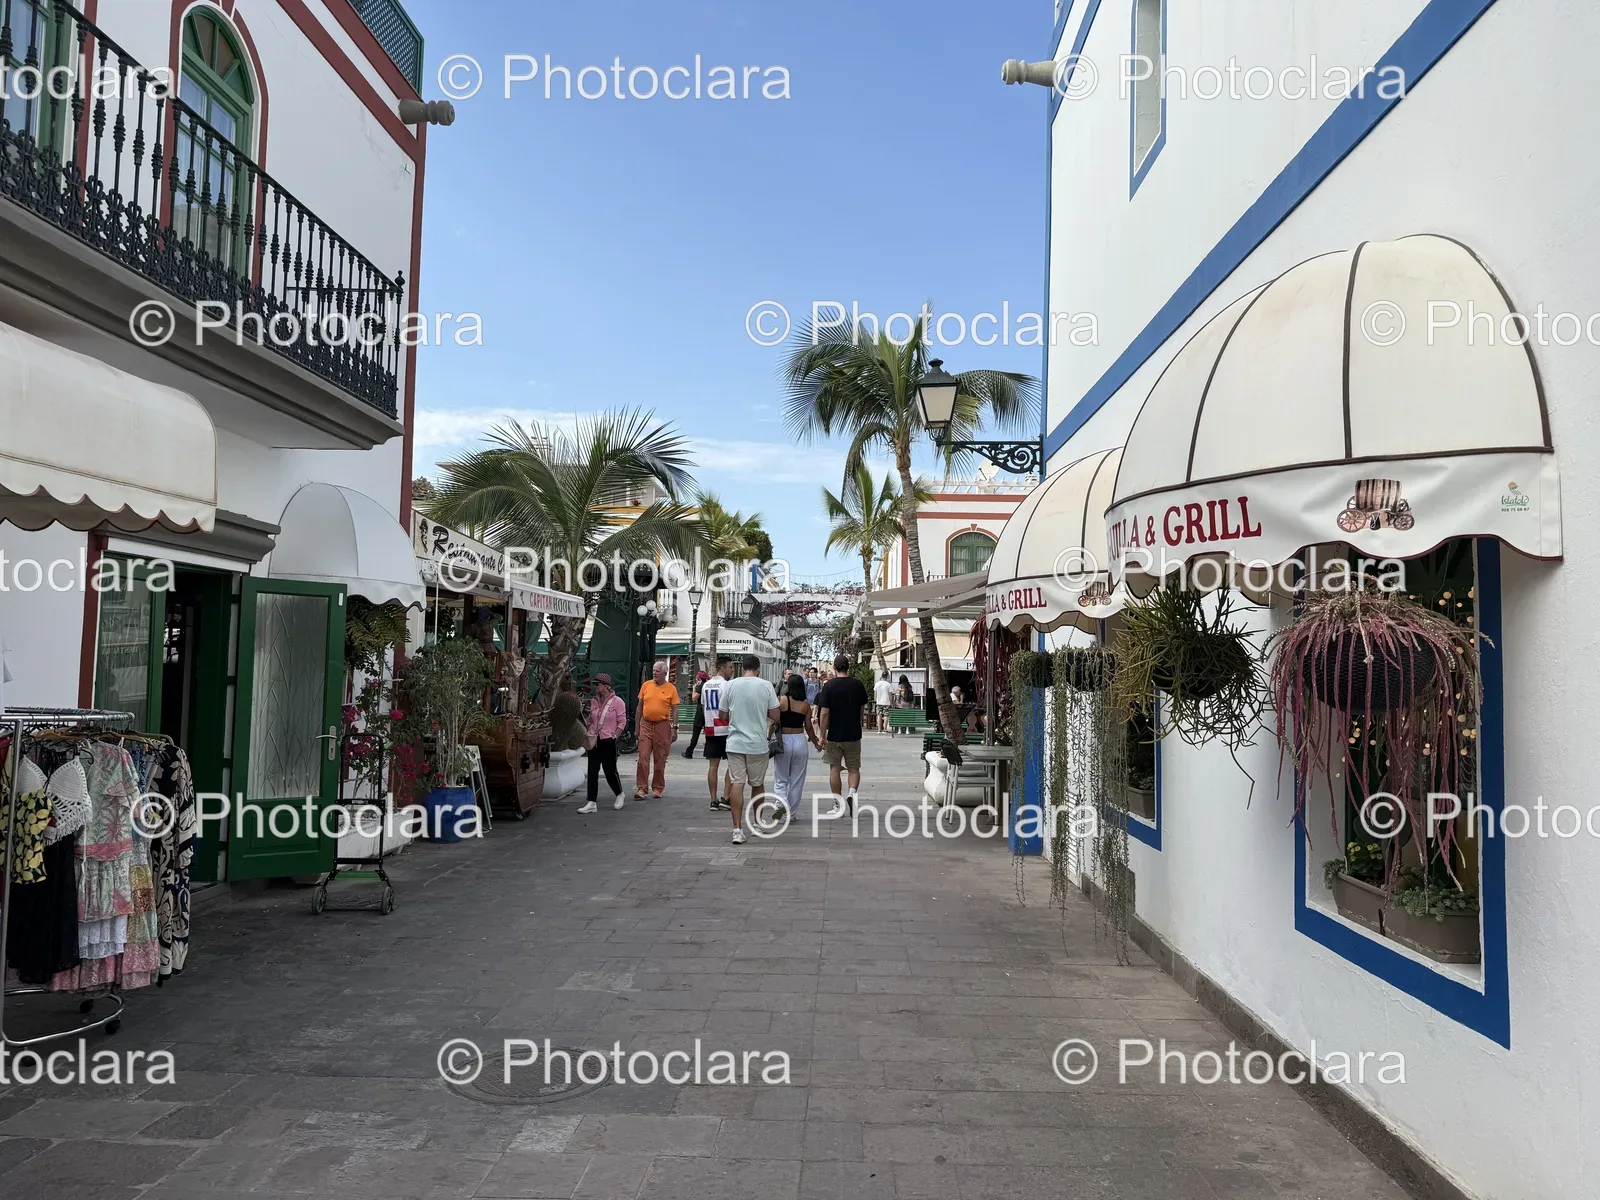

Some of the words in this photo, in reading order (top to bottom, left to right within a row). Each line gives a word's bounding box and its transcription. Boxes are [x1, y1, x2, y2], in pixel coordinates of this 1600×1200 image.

[1145, 515, 1156, 547] &
[1163, 496, 1262, 547] GRILL
[553, 597, 573, 615] HOOK
[1008, 587, 1047, 611] GRILL
[704, 689, 720, 711] 10
